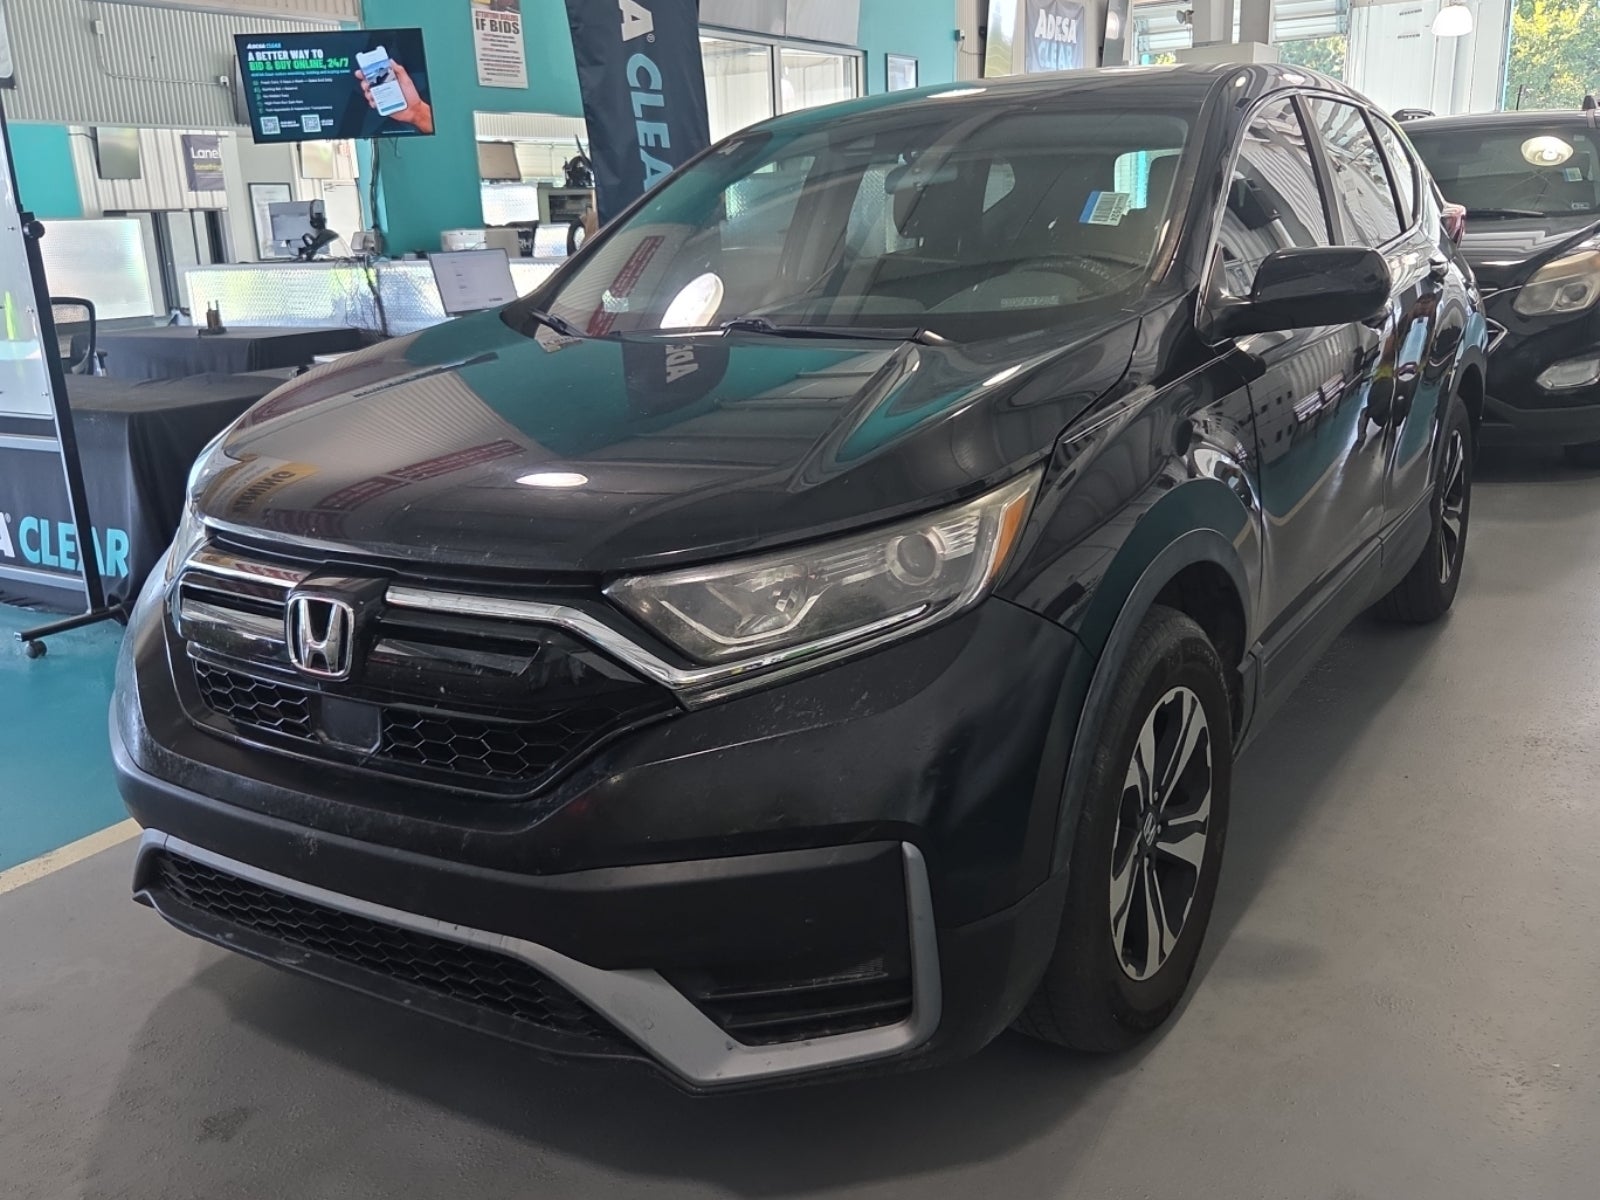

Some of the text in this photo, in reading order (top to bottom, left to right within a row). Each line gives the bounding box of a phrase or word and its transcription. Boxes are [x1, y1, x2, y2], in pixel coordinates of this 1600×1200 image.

[475, 17, 520, 35] IF BIDS
[1034, 8, 1077, 43] ADESA
[247, 48, 324, 61] A BETTER WAY TO
[1038, 41, 1073, 69] CLEAR
[248, 60, 265, 71] BID
[265, 60, 273, 71] &
[274, 59, 291, 70] BUY
[327, 57, 349, 68] 24/7
